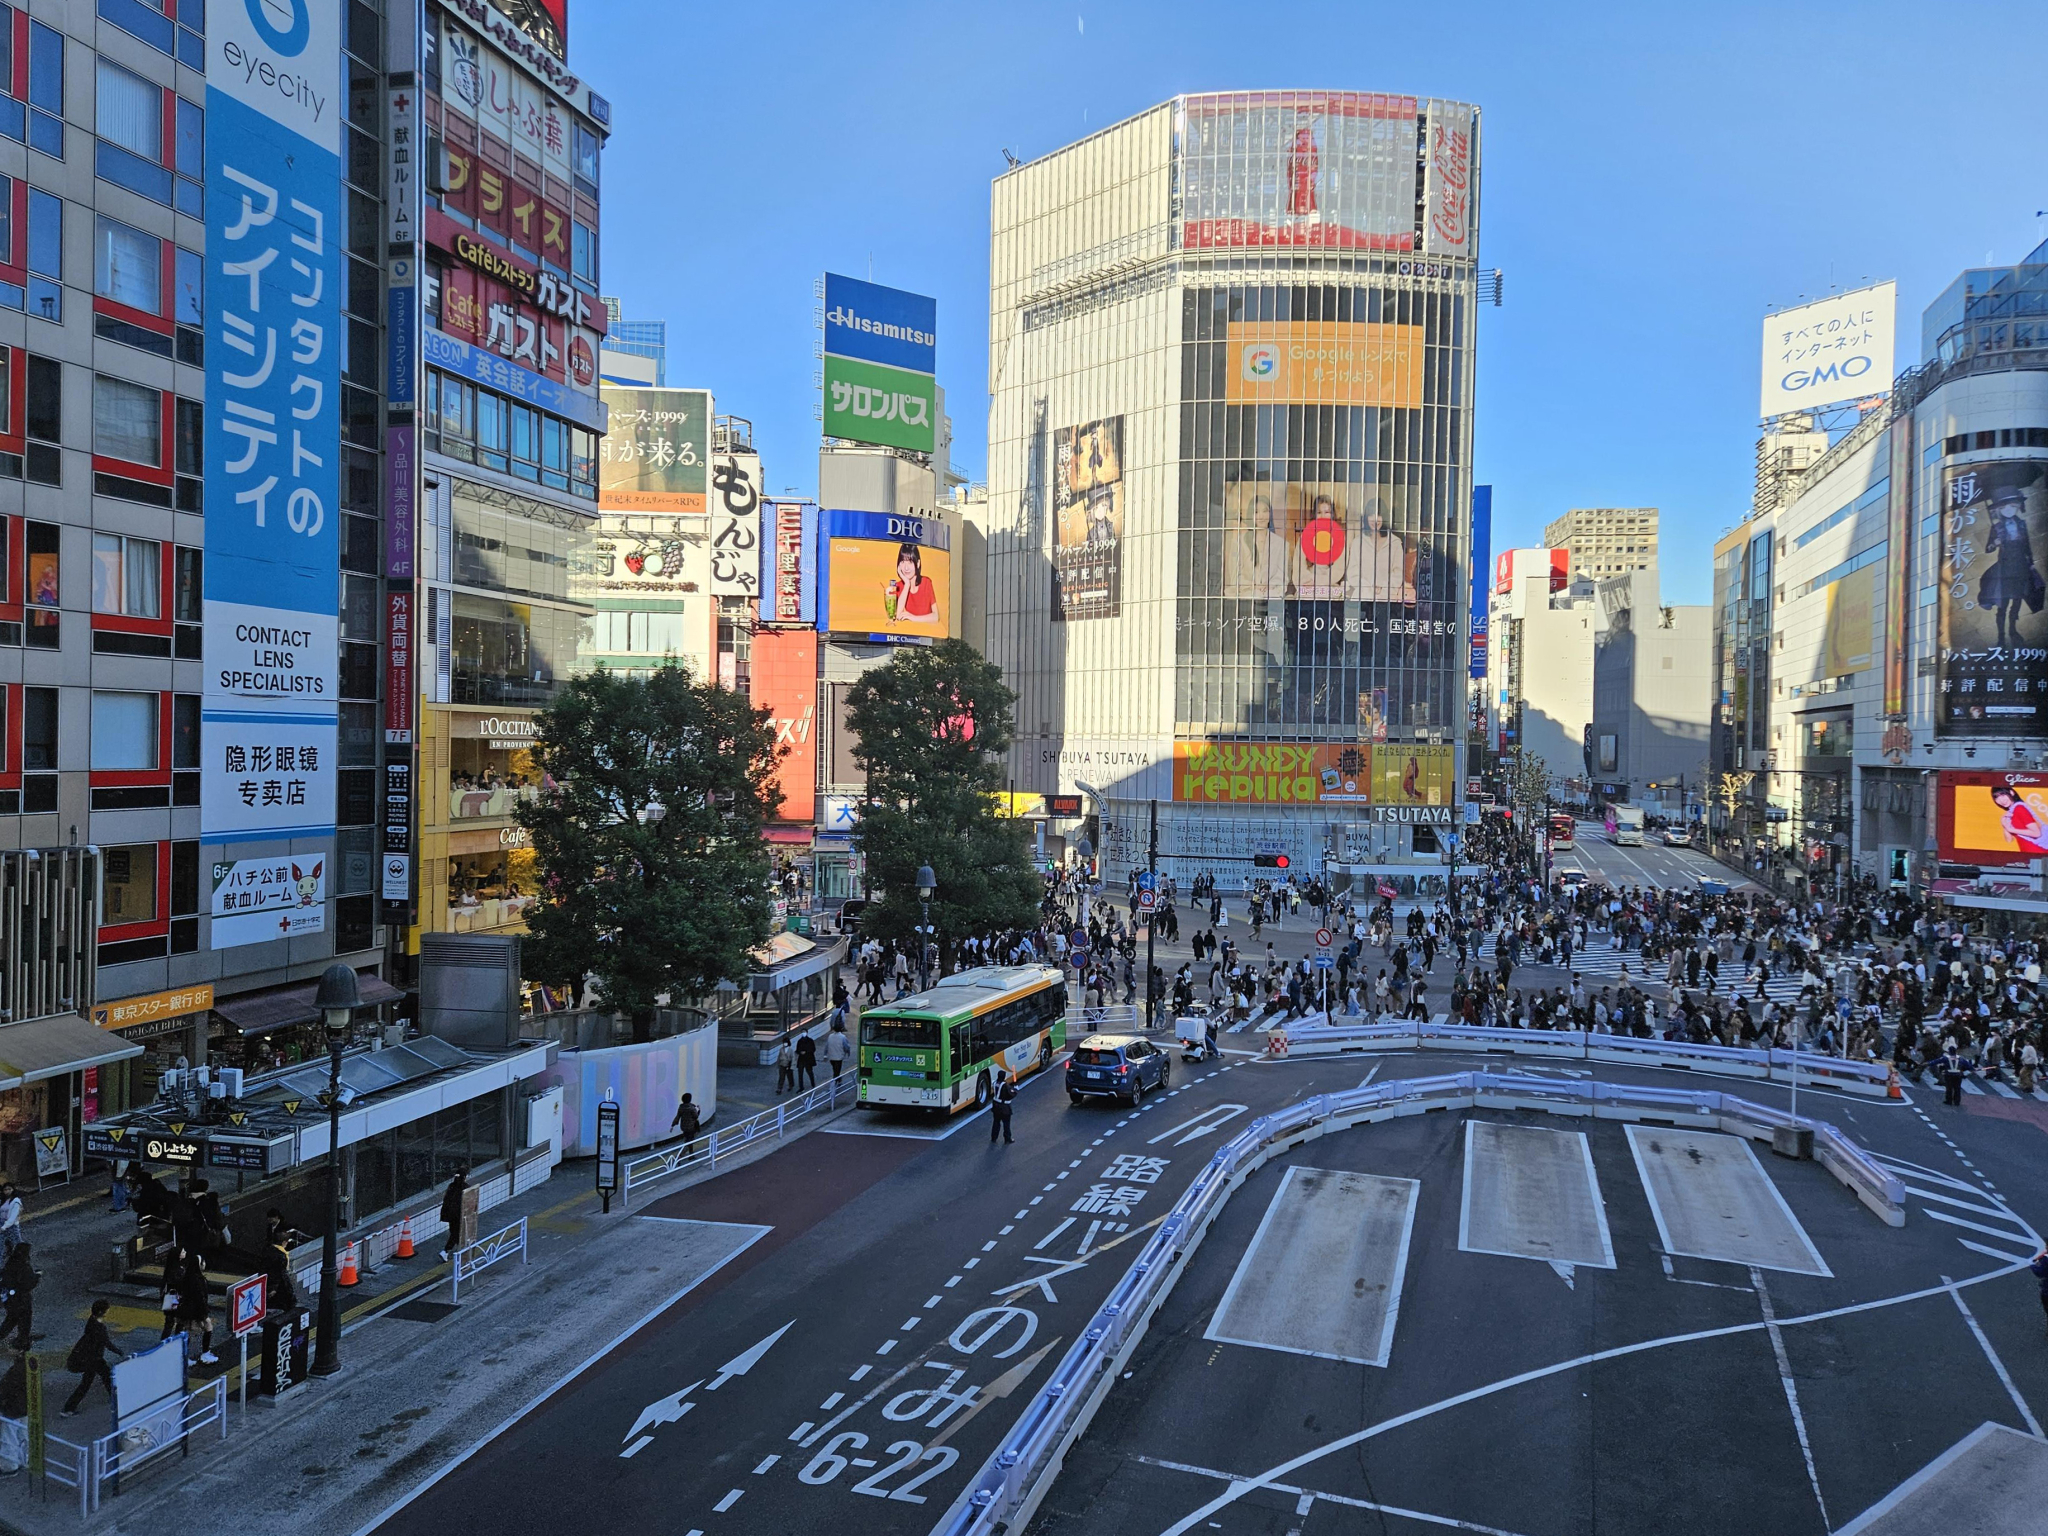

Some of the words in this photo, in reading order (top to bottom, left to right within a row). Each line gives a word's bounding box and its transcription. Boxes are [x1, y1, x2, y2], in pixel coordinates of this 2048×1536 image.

[223, 41, 325, 123] eyecity
[490, 69, 563, 156] しゃぶ葉
[393, 127, 409, 223] 献血ルーム
[1433, 119, 1468, 245] Coca-Cola
[395, 230, 409, 242] 6F
[538, 272, 591, 326] ガスト
[487, 302, 559, 371] ガスト
[827, 305, 935, 347] Hisamitsu
[1782, 310, 1874, 346] すべての人に
[223, 163, 279, 528] アイシティ
[424, 331, 461, 366] AEON
[1290, 345, 1355, 365] Google
[1781, 330, 1873, 364] インターネット
[287, 198, 324, 537] コンタクトの
[475, 352, 526, 395] 英会話
[1311, 367, 1374, 383] 見つけよう
[1781, 355, 1872, 391] GMO
[831, 380, 929, 429] サロンパス
[394, 453, 409, 553] 品川美容外科
[605, 495, 632, 505] 世紀末
[635, 496, 700, 506] タイムリバースRPG
[712, 456, 758, 593] もんじゃ
[886, 517, 924, 539] DHC
[835, 544, 861, 554] Google
[1945, 471, 1981, 610] 雨が来る。
[391, 562, 410, 574] 4F
[236, 624, 312, 648] CONTACT
[392, 595, 408, 668] 外貨両替
[254, 649, 294, 669] LENS
[220, 671, 324, 694] SPECIALISTS
[1940, 678, 2048, 693] 好評配信中
[391, 730, 407, 742] 7F
[225, 745, 319, 774] 隐形眼镜
[1042, 750, 1092, 764] SHIBUYA
[1096, 752, 1150, 766] TSUTAYA
[1183, 745, 1320, 773] VAUNDY
[238, 779, 307, 808] 专卖店
[1183, 774, 1317, 801] replica
[2005, 774, 2041, 786] Glico
[1375, 807, 1452, 822] TSUTAYA
[499, 827, 526, 848] Café
[1256, 842, 1287, 850] 渋谷駅前
[213, 864, 229, 879] 6F
[229, 867, 288, 888] ハチ公前
[223, 887, 293, 911] 献血ルーム
[113, 993, 193, 1022] 東京スター銀行
[194, 990, 210, 1005] 8F
[607, 1089, 612, 1099] 1
[797, 1432, 960, 1505] 6-22
